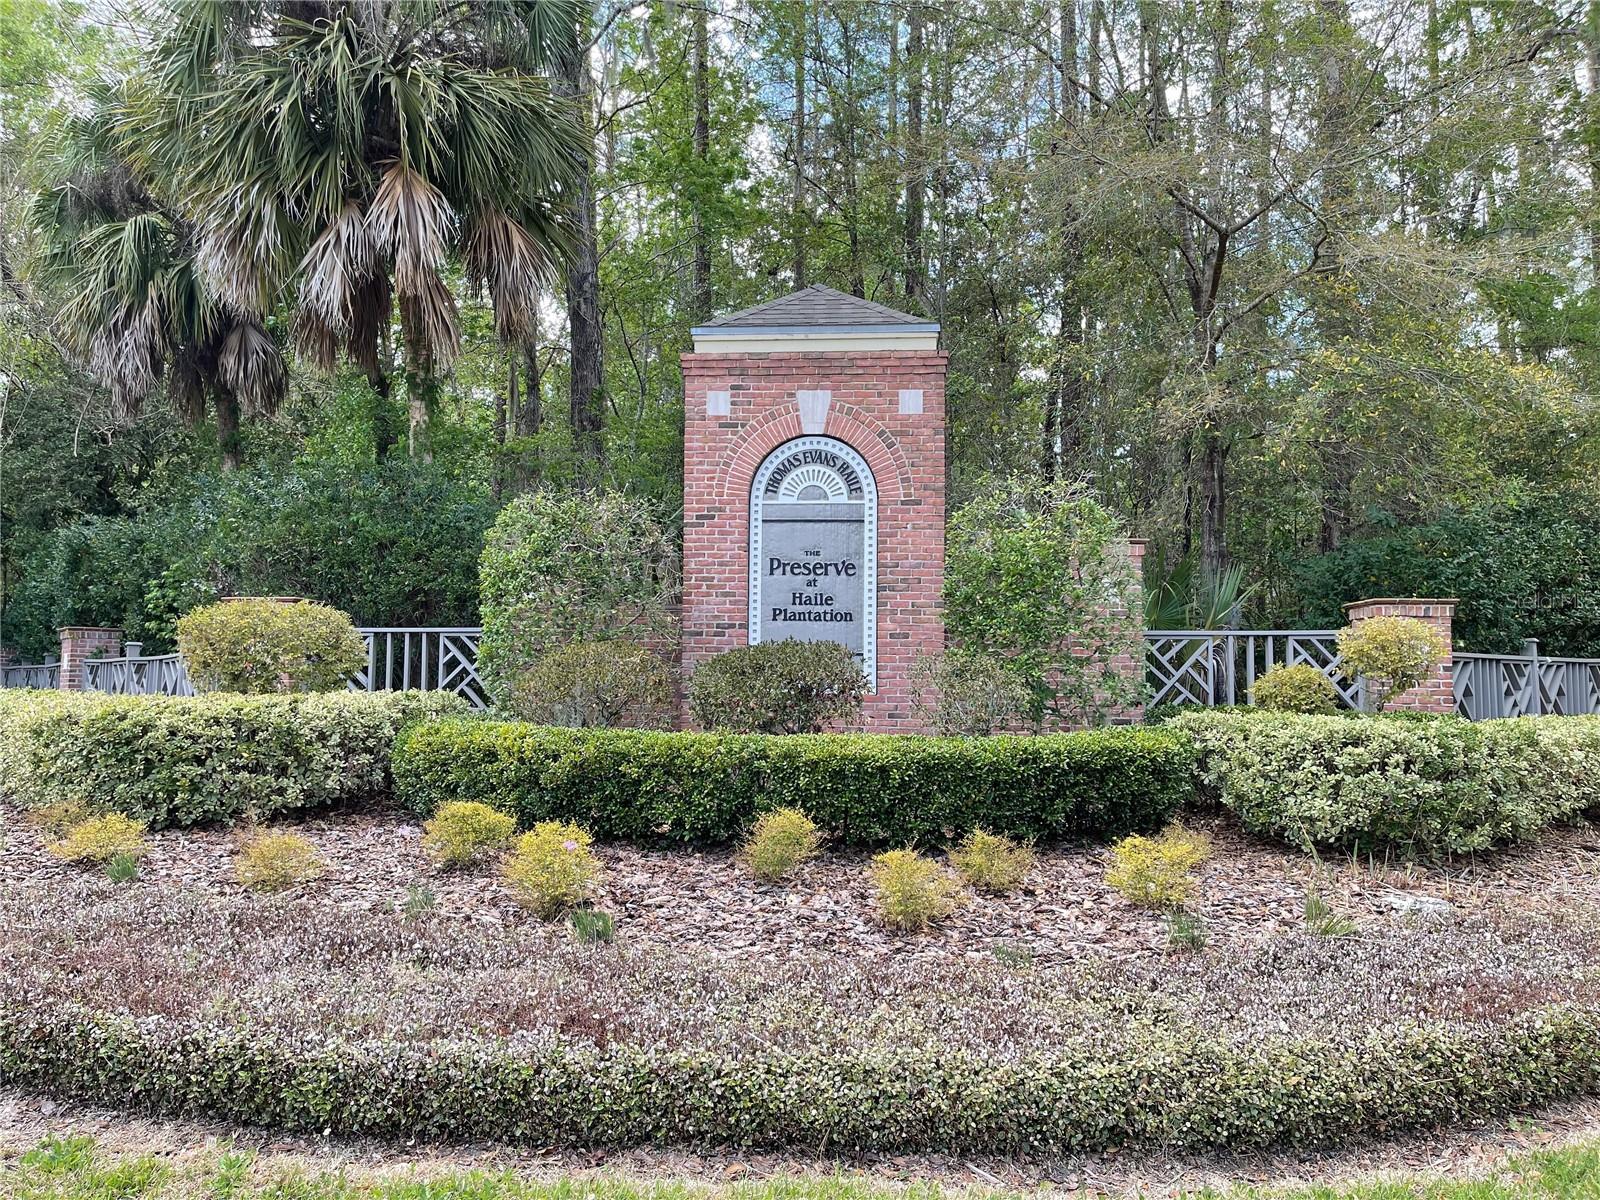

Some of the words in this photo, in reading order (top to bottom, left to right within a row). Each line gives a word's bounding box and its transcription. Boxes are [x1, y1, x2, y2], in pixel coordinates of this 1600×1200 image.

[765, 454, 802, 494] THOMAS
[803, 450, 838, 468] EVANS
[837, 461, 862, 495] HAILE
[769, 557, 857, 576] Preserve
[806, 577, 818, 587] at
[792, 592, 834, 606] Haile
[772, 608, 853, 622] Plantation
